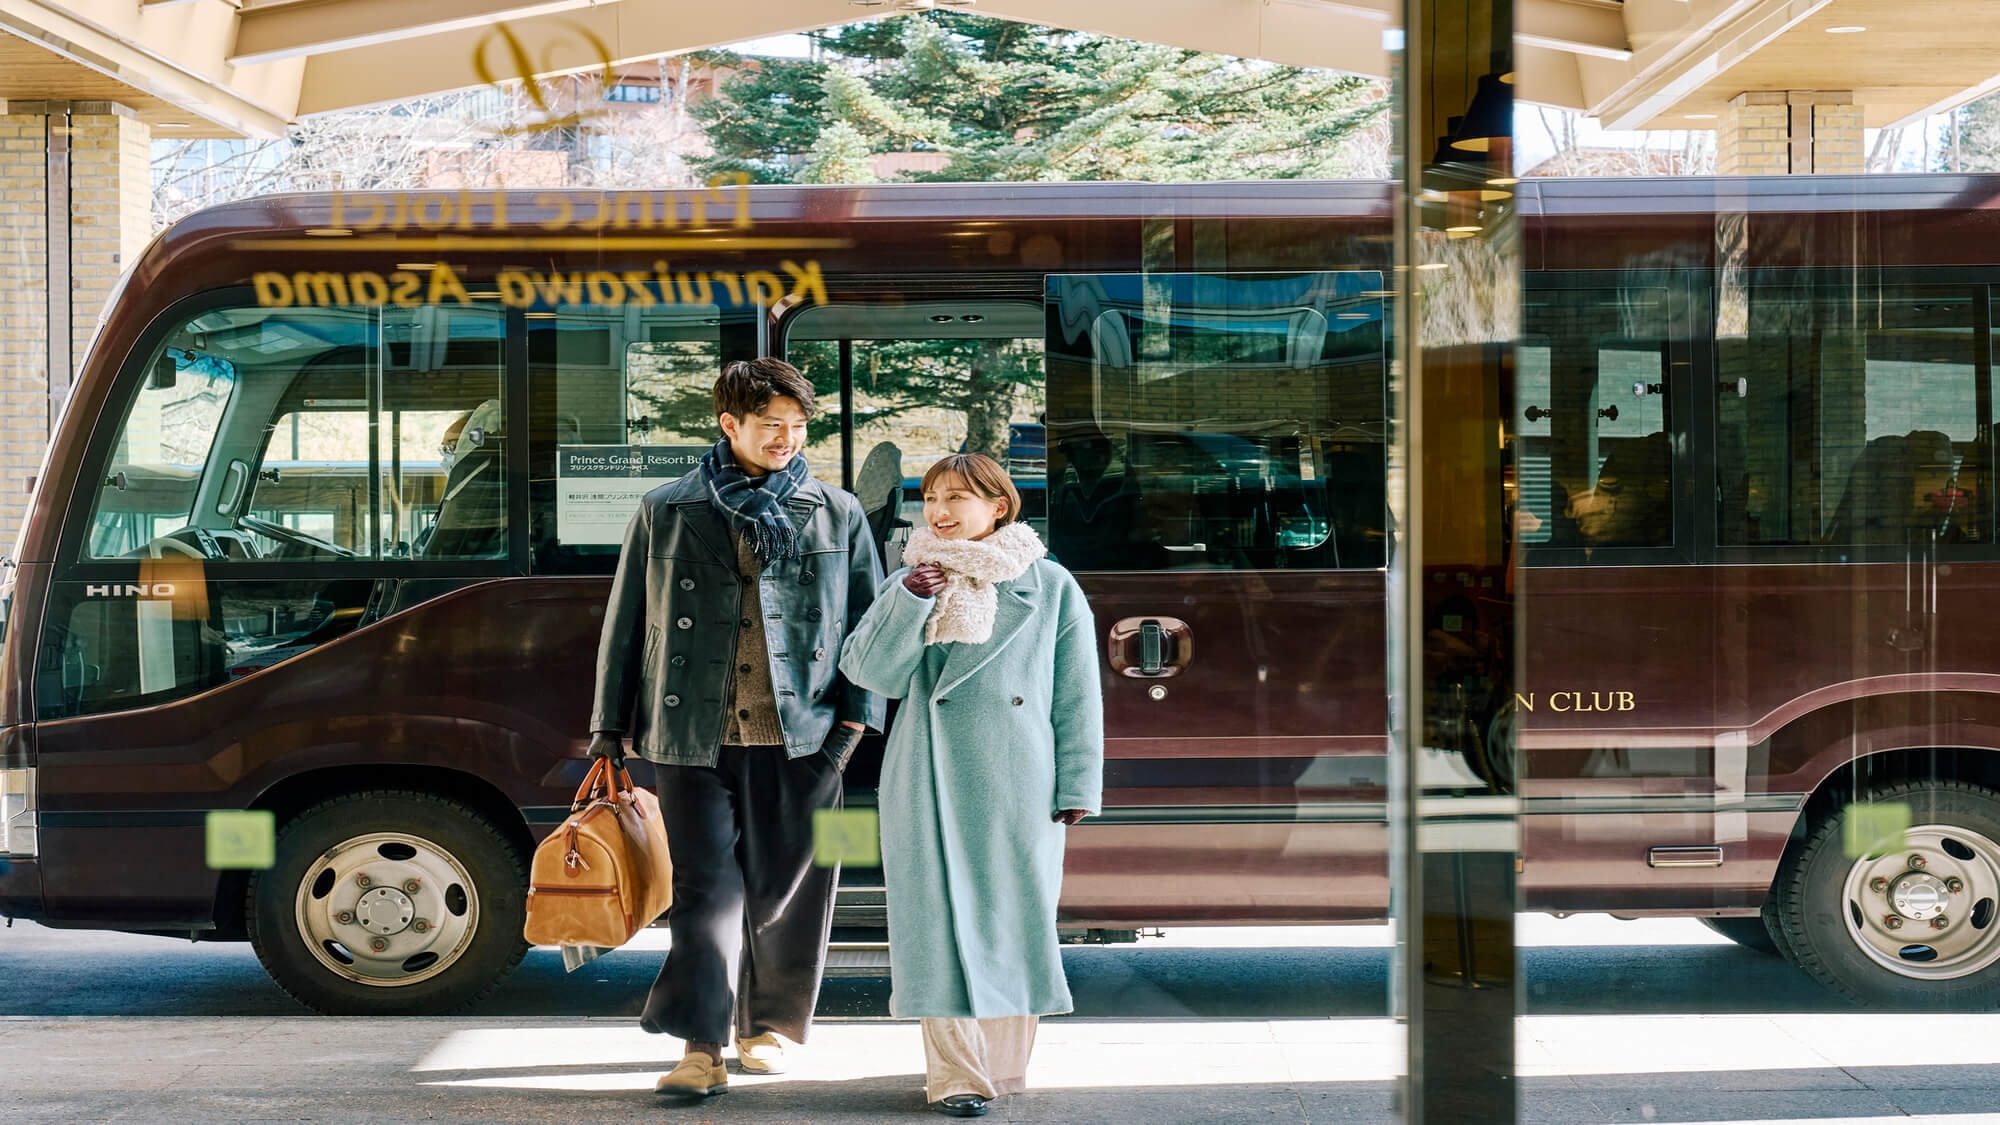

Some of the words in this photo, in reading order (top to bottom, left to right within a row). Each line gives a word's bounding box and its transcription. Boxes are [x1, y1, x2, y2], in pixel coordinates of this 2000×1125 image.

[570, 455, 605, 464] Prince
[608, 455, 644, 464] Grand
[647, 455, 684, 464] Resort
[86, 583, 176, 597] HINO
[1549, 691, 1636, 712] CLUB
